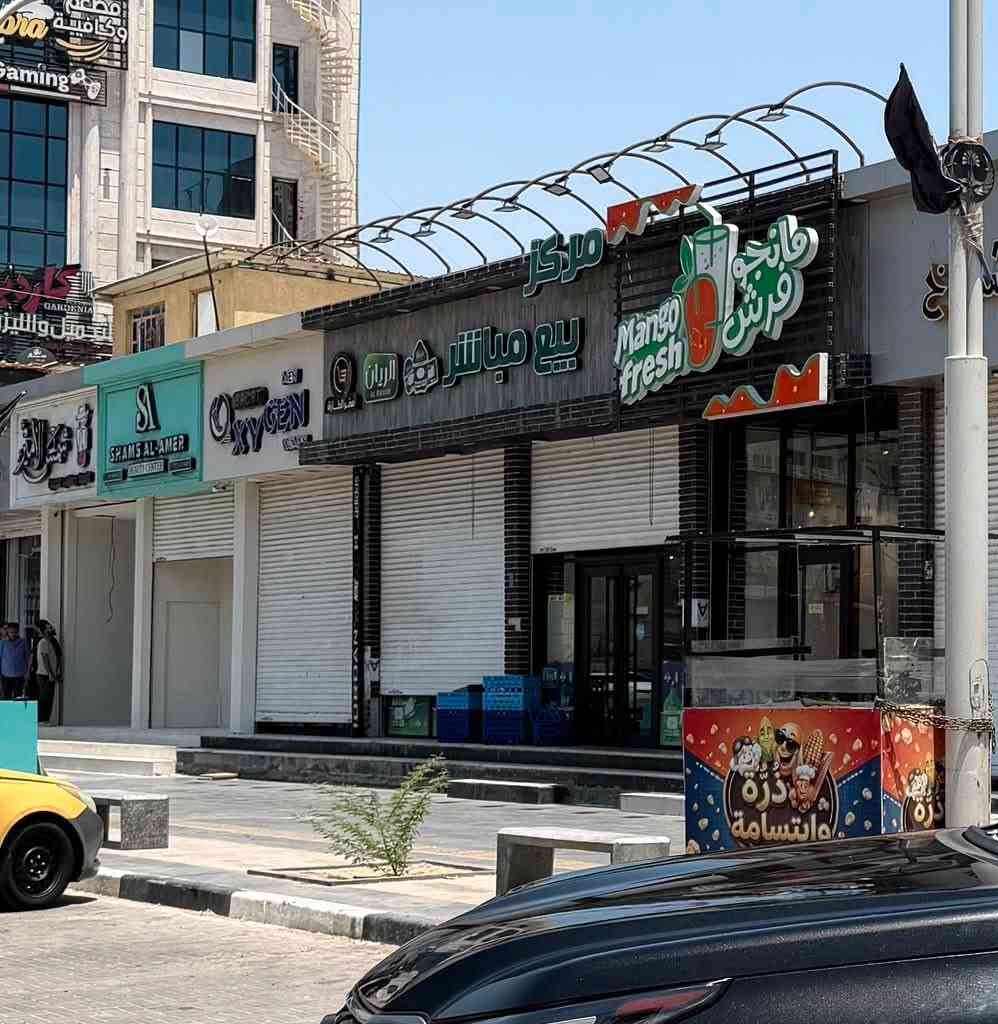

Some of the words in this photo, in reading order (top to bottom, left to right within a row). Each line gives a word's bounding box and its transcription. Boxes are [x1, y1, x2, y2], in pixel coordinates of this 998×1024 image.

[523, 229, 605, 297] مركز
[442, 326, 528, 388] مباشر
[533, 317, 581, 376] بيع
[616, 299, 682, 364] Mango
[621, 340, 683, 402] fresh
[110, 442, 142, 463] SHAMS
